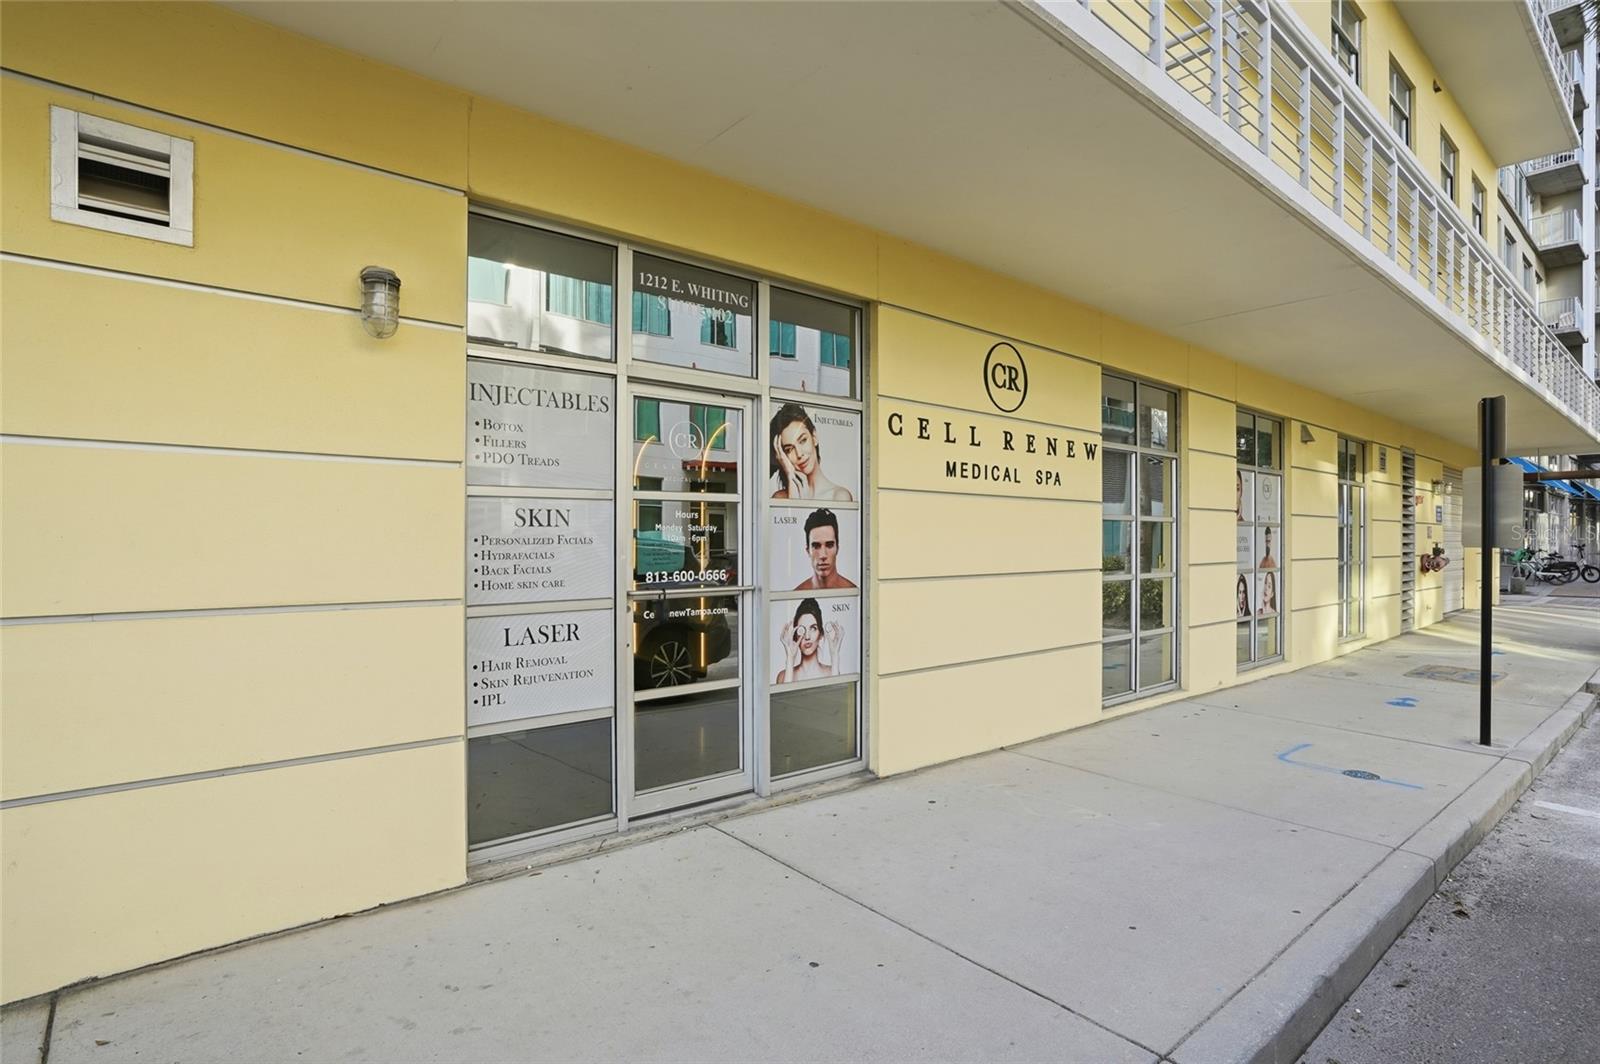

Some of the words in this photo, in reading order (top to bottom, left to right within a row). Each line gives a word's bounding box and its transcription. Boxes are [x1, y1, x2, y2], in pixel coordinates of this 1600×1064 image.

[639, 272, 668, 290] 1212
[671, 279, 685, 294] E.
[688, 282, 749, 308] WHITING
[991, 362, 1022, 393] CR
[469, 382, 610, 414] INJECTABLES
[675, 432, 698, 449] CR
[887, 412, 981, 447] CELL
[1003, 430, 1099, 461] RENEW
[483, 452, 515, 465] PDO
[945, 460, 1021, 484] MEDICAL
[1035, 469, 1062, 487] SPA
[514, 507, 571, 528] SKIN
[675, 510, 699, 519] Hours
[773, 516, 798, 525] LASER
[688, 523, 718, 535] Saturday
[645, 569, 726, 584] 813-600-0666
[832, 603, 851, 613] SKIN
[503, 622, 581, 647] LASER
[481, 693, 506, 707] IPL
